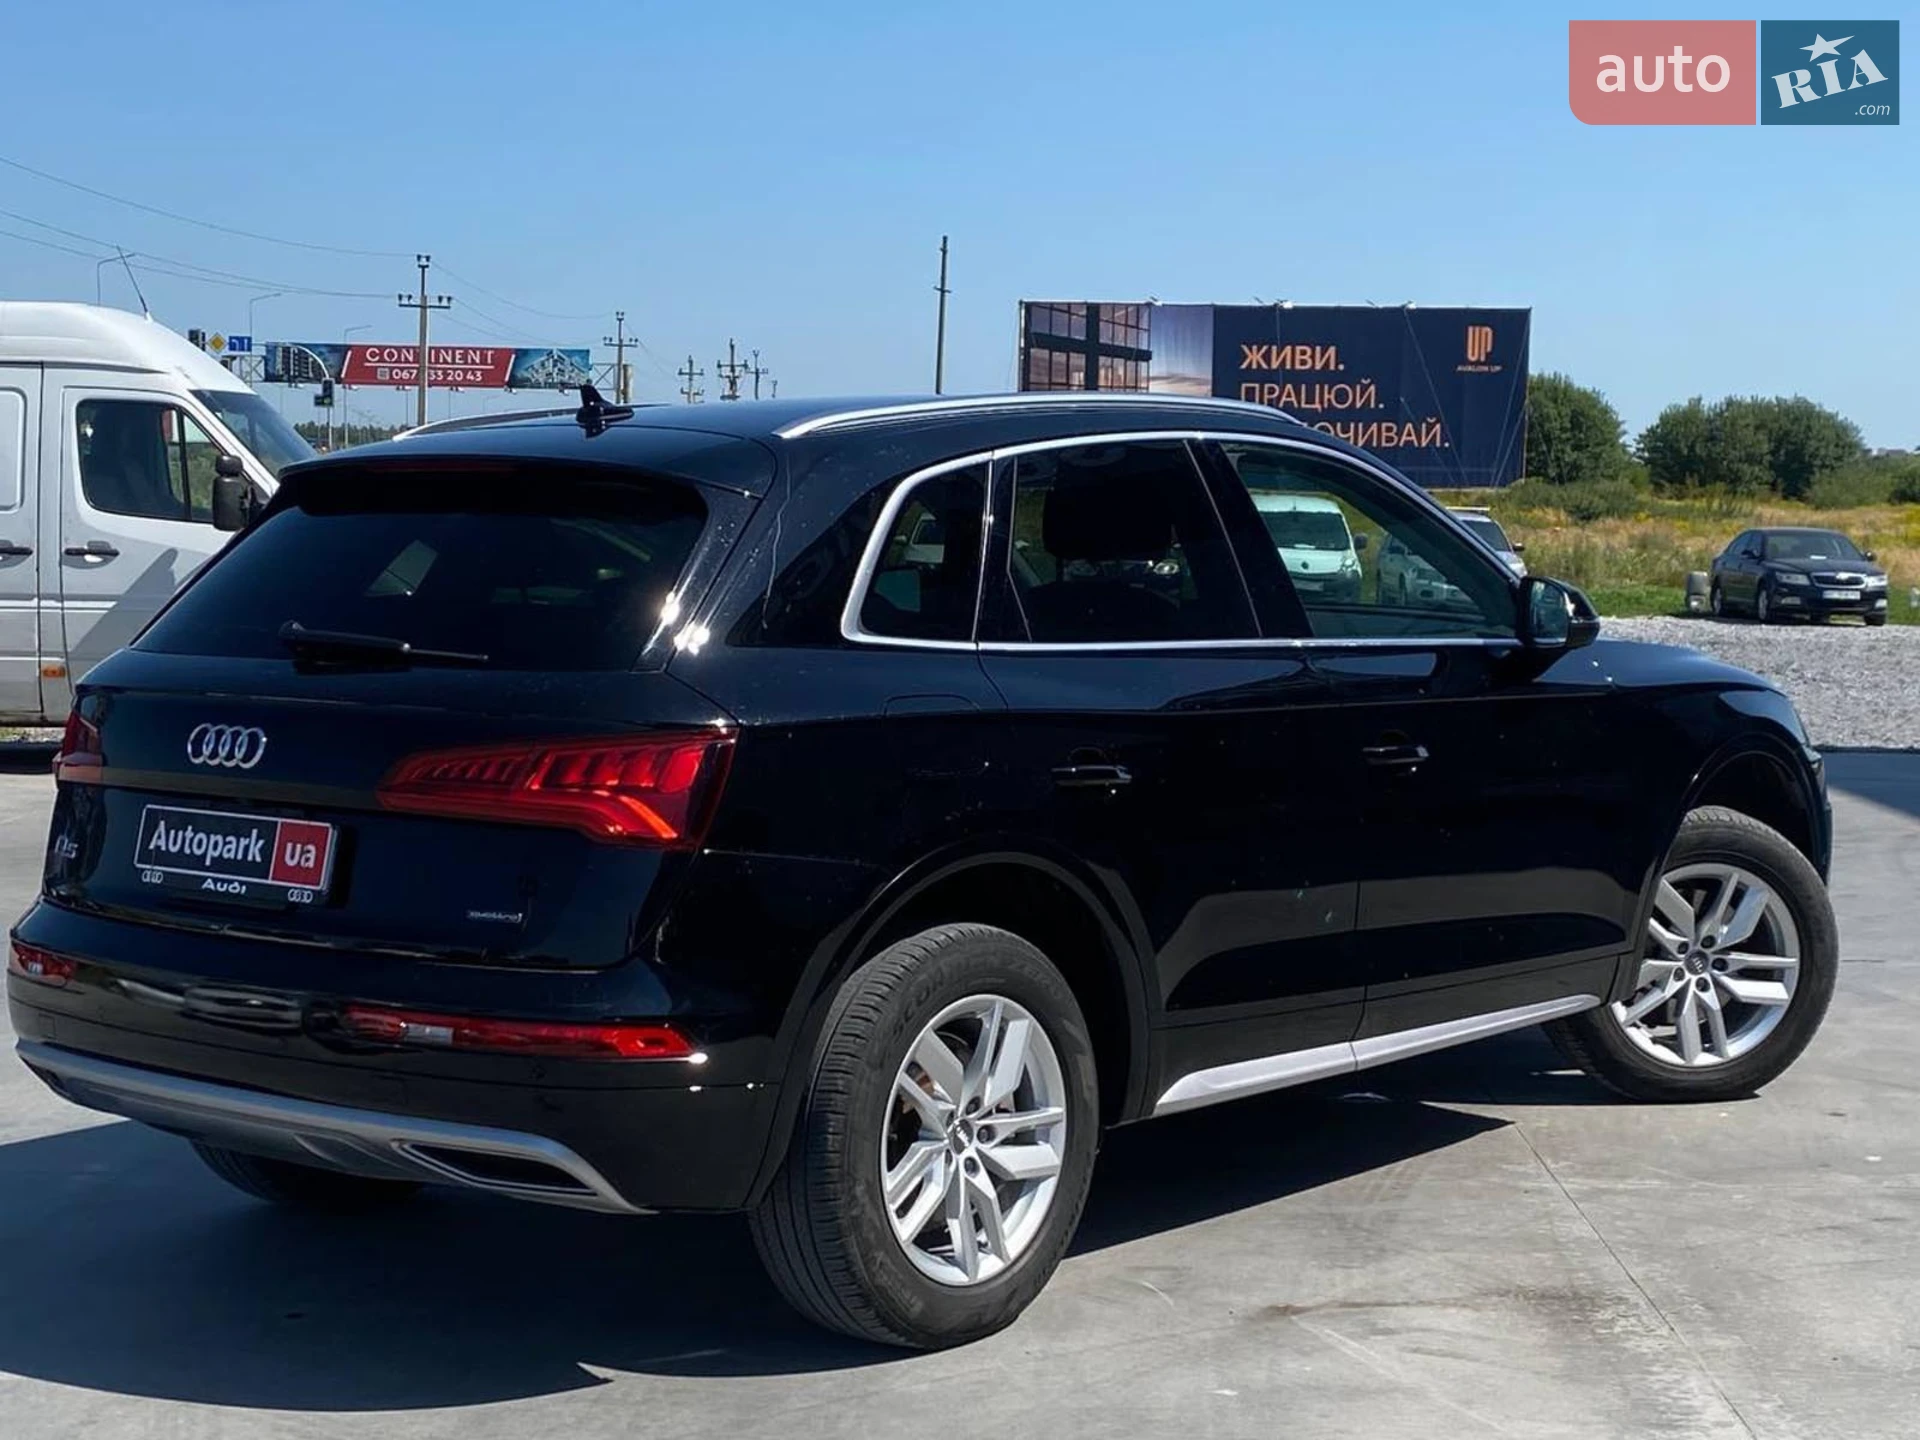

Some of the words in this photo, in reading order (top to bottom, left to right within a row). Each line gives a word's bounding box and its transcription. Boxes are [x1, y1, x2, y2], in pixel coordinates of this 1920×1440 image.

[365, 347, 495, 364] CONINENT
[1239, 344, 1345, 372] ЖИВИ.
[392, 368, 418, 380] 067
[446, 370, 464, 381] 20
[466, 370, 483, 382] 43
[1240, 377, 1385, 413] ПРАЦЮЙ.
[148, 820, 265, 867] Autopark
[283, 842, 317, 869] ua
[201, 878, 247, 895] Audi
